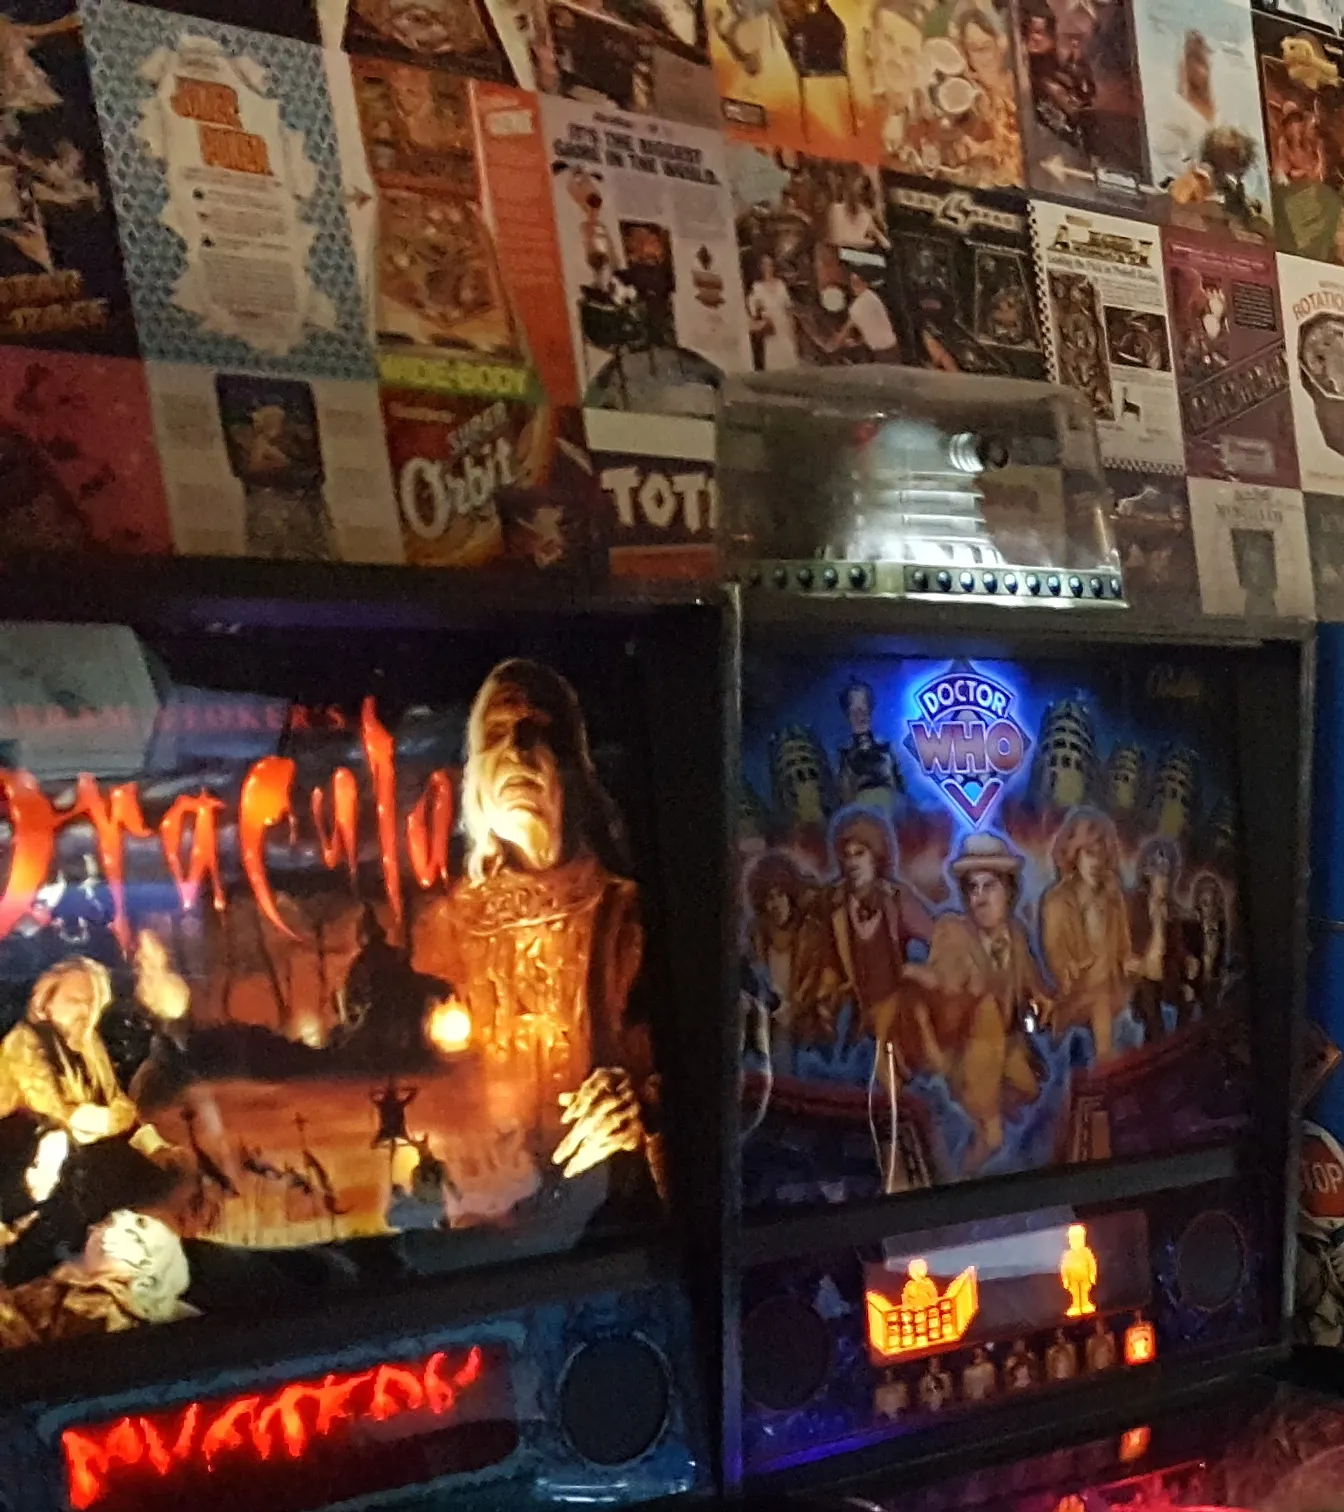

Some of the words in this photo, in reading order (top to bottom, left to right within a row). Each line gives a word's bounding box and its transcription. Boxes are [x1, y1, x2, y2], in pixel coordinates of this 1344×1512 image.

[603, 130, 635, 151] THE
[400, 436, 517, 541] Orbit
[922, 679, 1007, 716] DOCTOR
[907, 717, 1025, 776] WHO
[1300, 1161, 1343, 1194] TOP
